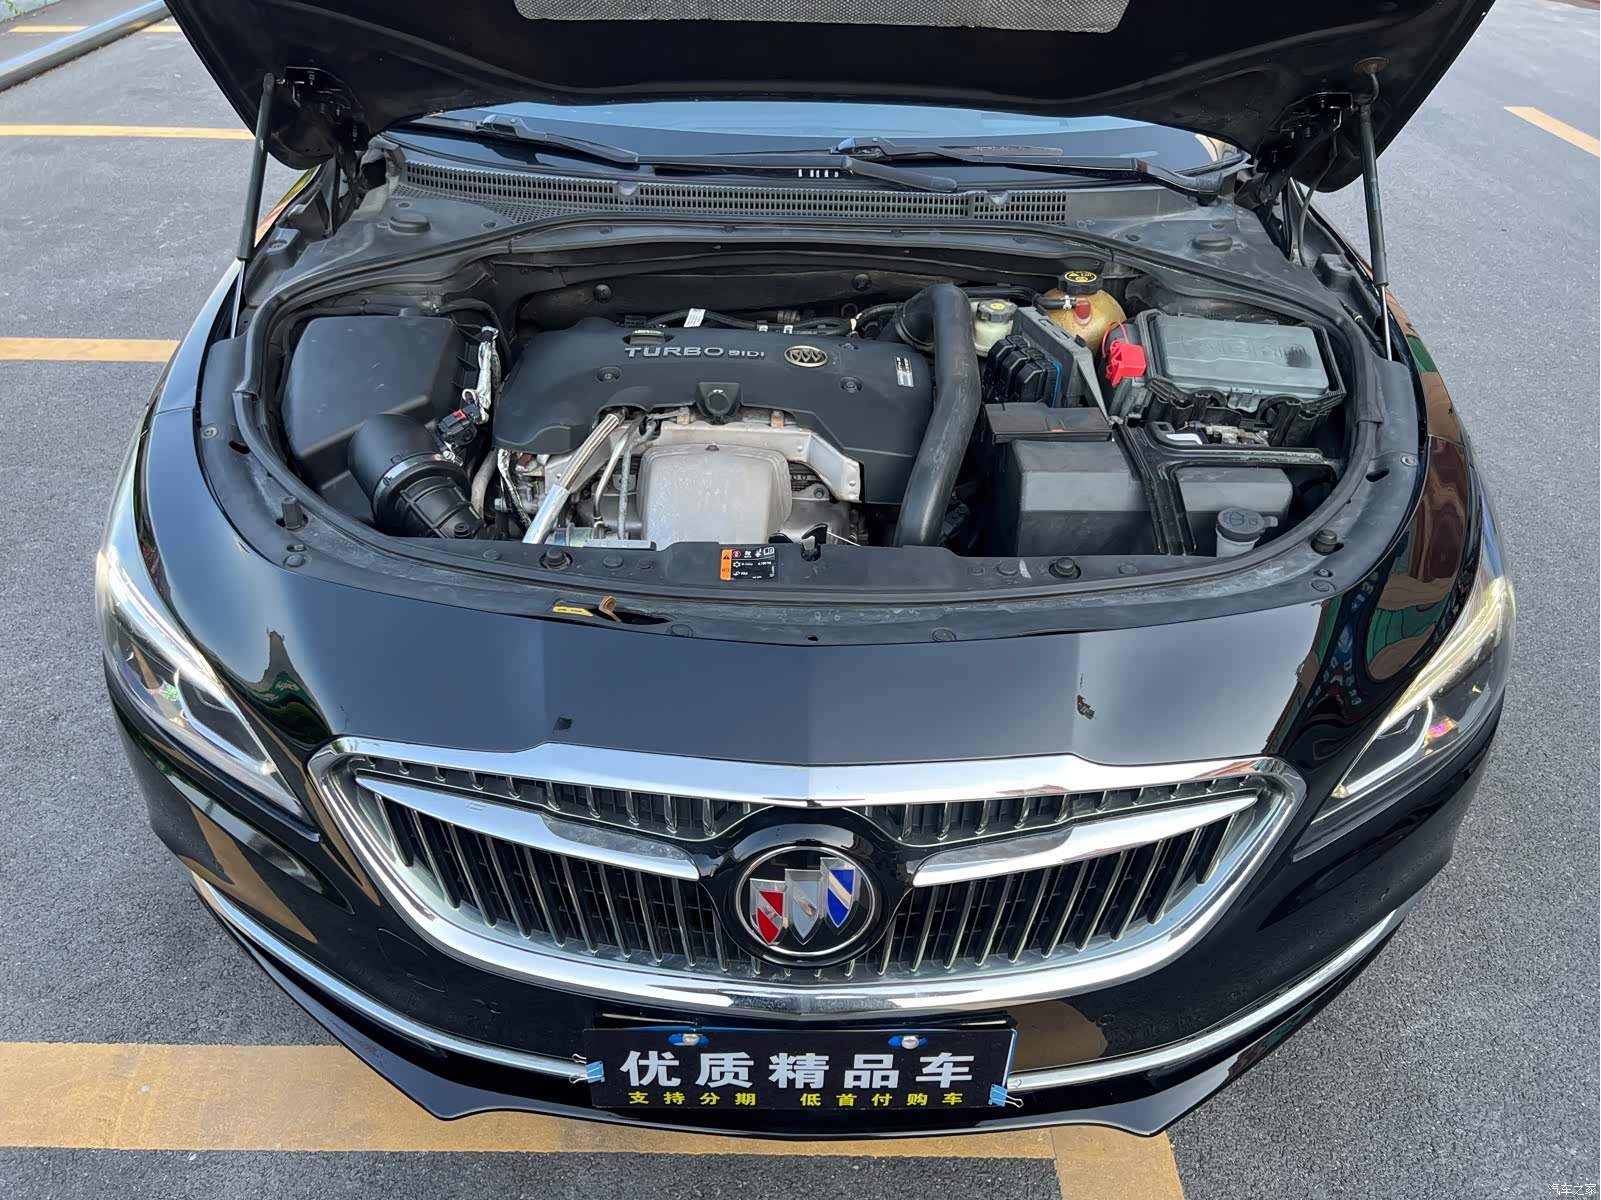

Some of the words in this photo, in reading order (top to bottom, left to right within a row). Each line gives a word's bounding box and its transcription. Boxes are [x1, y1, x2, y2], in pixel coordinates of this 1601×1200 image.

[624, 346, 724, 358] TURBO
[620, 1050, 974, 1089] 优质精品车
[628, 1091, 756, 1106] 支持分期
[800, 1093, 964, 1107] 低首付购车
